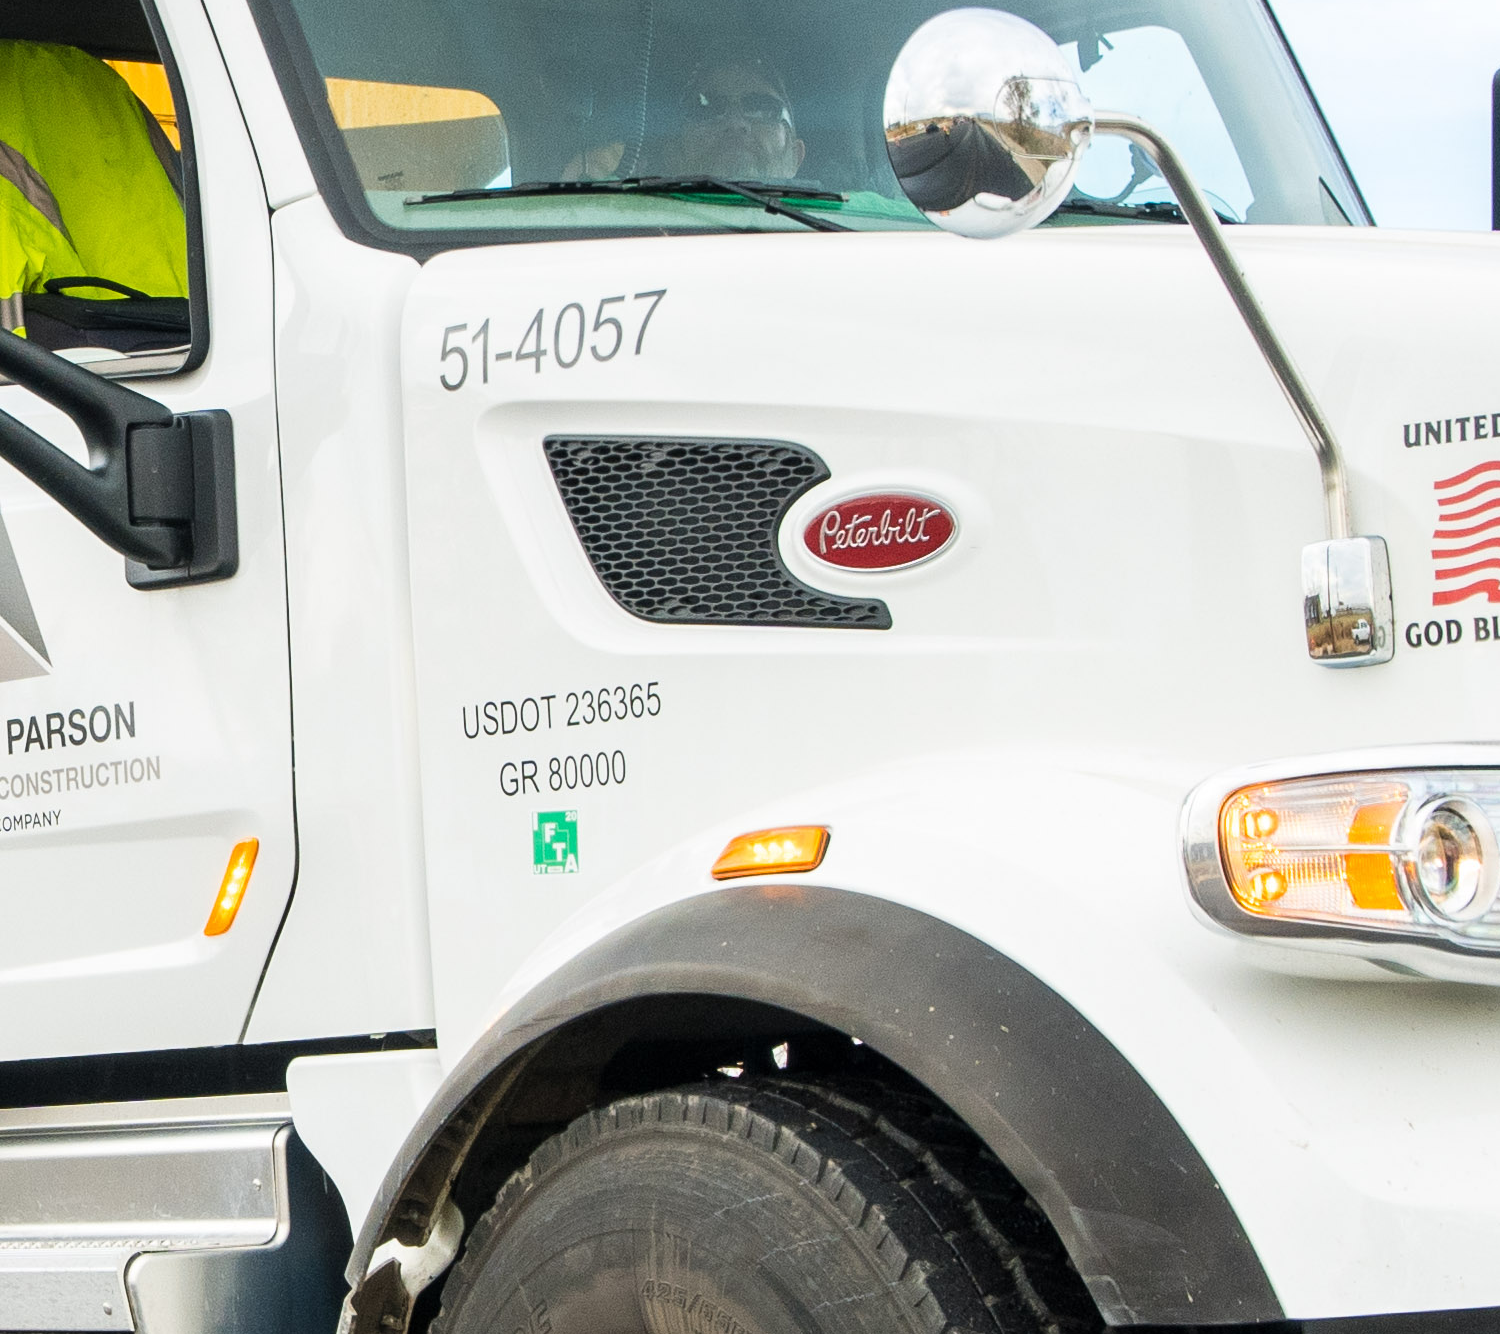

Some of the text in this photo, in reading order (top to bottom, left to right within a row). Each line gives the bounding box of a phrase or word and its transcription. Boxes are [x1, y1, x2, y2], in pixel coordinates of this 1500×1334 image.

[438, 288, 668, 391] 51-4057
[818, 505, 942, 554] Peterbilt
[1404, 619, 1463, 648] GOD
[6, 701, 137, 754] PARSON
[462, 682, 662, 739] USDOT 236365
[499, 749, 627, 796] GR 80000
